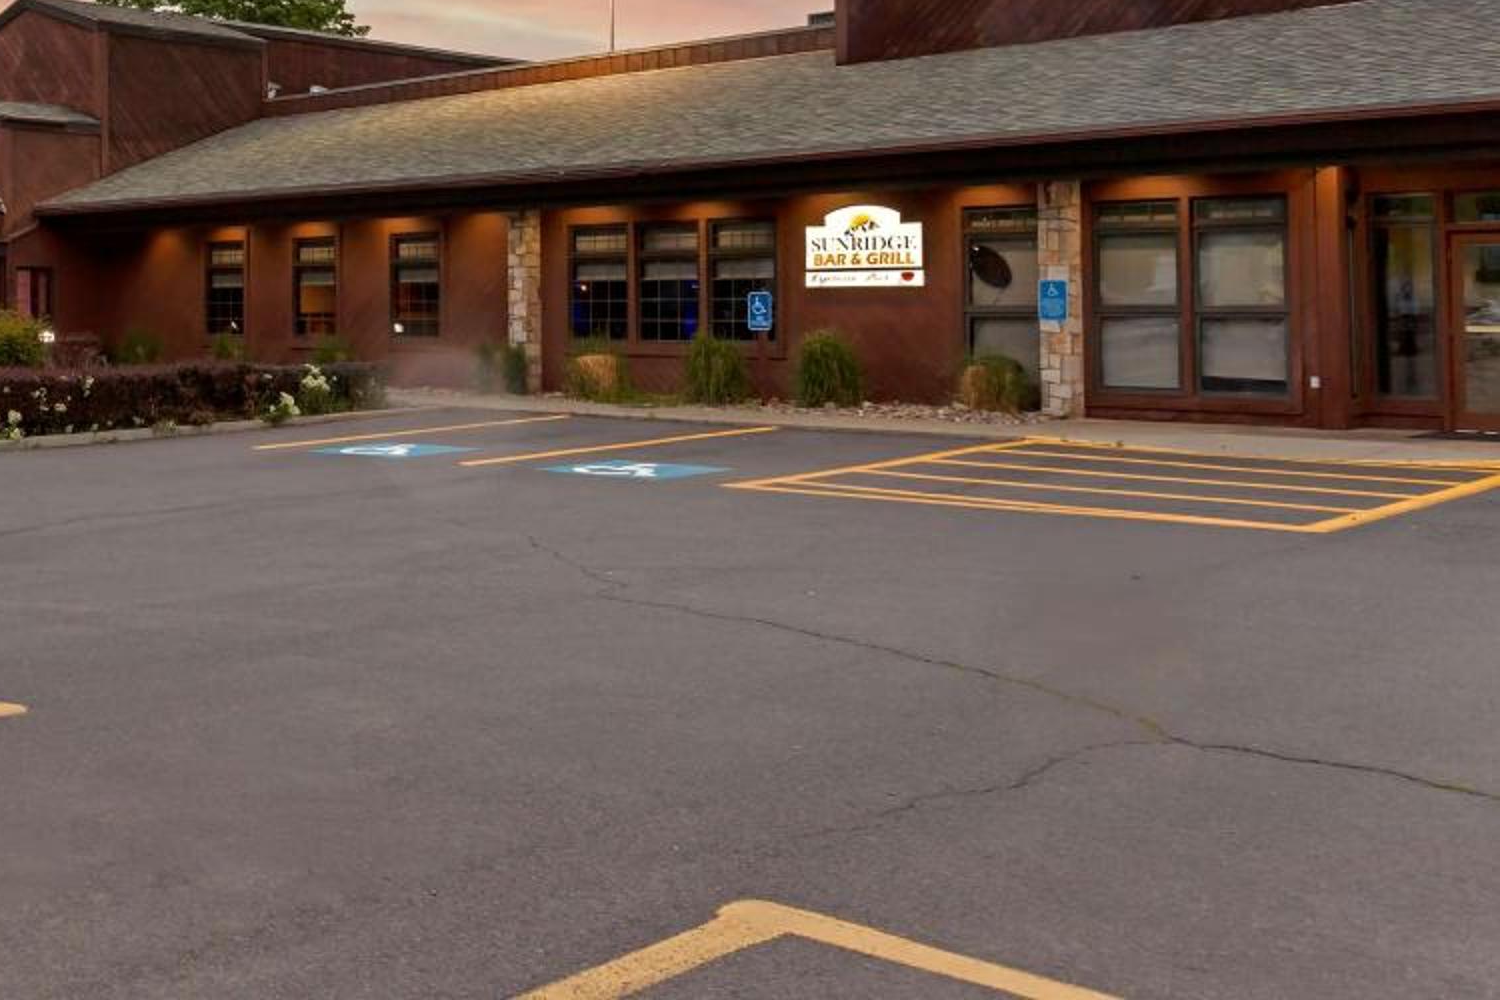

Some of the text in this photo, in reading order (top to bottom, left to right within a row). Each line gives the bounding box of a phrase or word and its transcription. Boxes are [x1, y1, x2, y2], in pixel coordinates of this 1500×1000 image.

[811, 235, 917, 252] SUNRIDGE
[813, 252, 915, 266] BAR & GRILL
